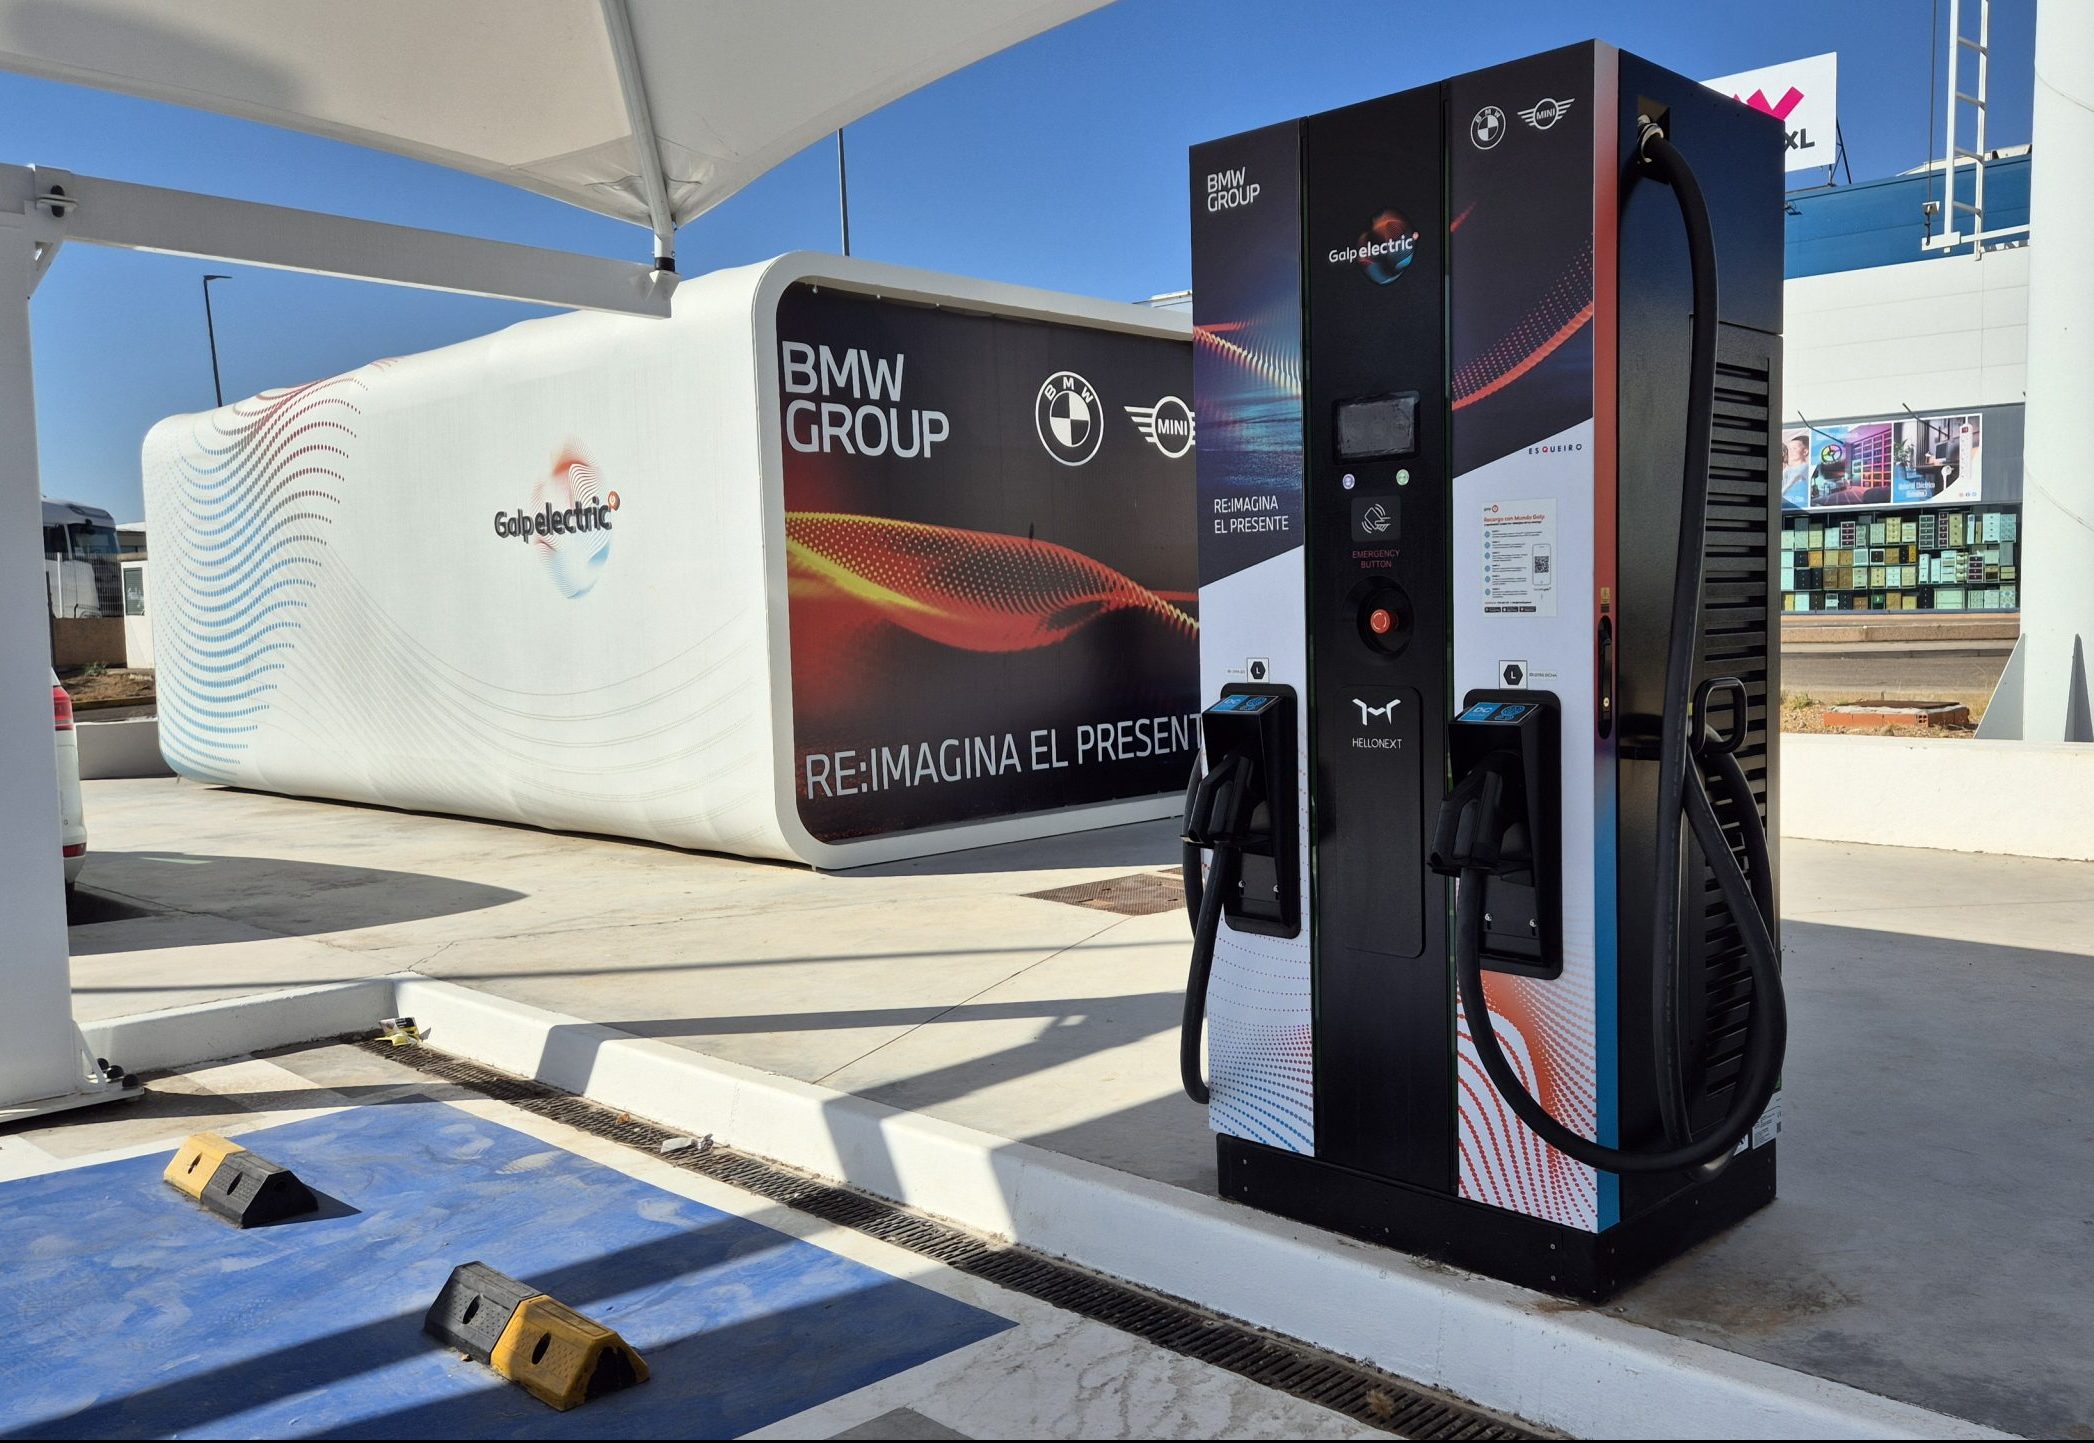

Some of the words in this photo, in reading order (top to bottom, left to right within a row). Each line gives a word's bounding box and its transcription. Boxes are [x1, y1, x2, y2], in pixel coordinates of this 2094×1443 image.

[1536, 107, 1556, 120] MINI
[1207, 166, 1246, 193] BMW
[1207, 183, 1261, 213] GROUP
[781, 340, 905, 402] BMW
[1044, 376, 1094, 404] BMW
[786, 399, 950, 459] GROUP
[1157, 418, 1188, 436] MINI
[1528, 443, 1583, 455] ESQUEIRO
[1214, 495, 1279, 514] RE:IMAGINA
[1214, 519, 1228, 534] EL
[1230, 515, 1289, 533] PRESENTE
[1352, 549, 1400, 559] EMERGENCY
[1360, 560, 1392, 569] BUTTON
[1352, 737, 1402, 749] HELLONEXT
[806, 733, 1022, 800] RE:IMAGINA
[1030, 729, 1069, 771] EL
